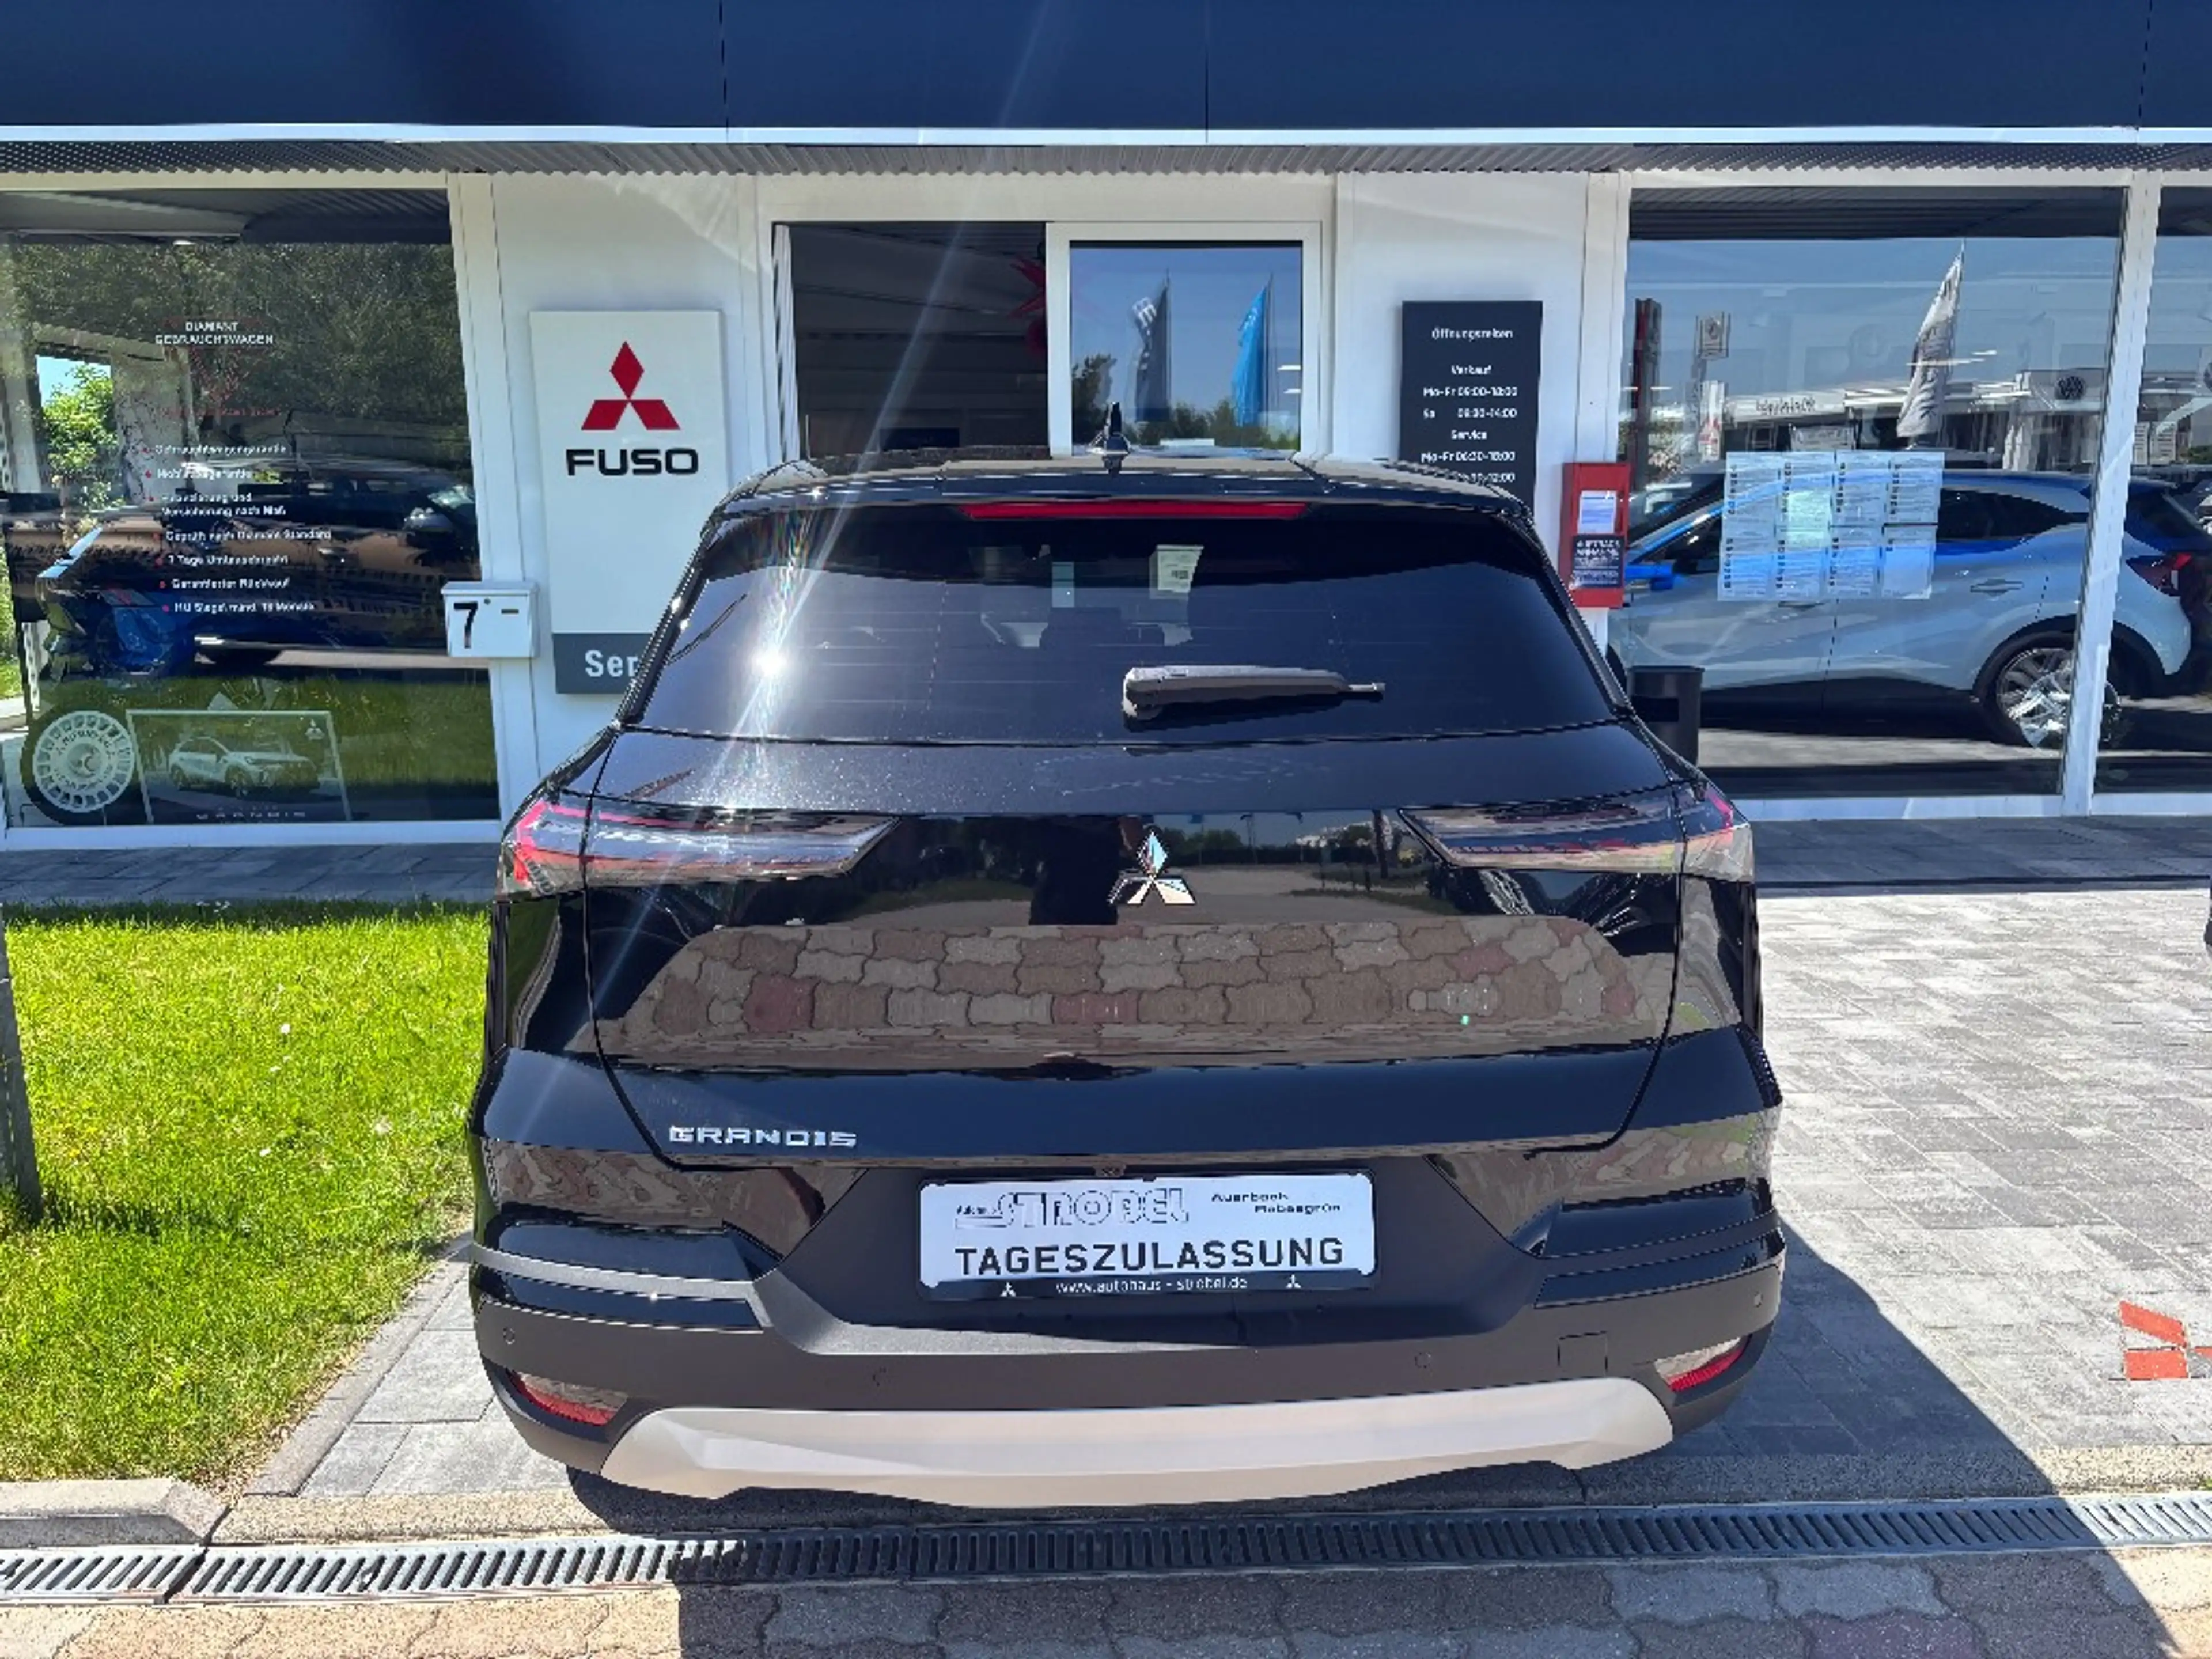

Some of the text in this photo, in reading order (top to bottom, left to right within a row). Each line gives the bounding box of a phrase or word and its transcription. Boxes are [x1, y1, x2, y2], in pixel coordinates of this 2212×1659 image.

[185, 321, 239, 332] DIAMANT
[155, 334, 274, 344] GEBRAUCHTWAGEN
[566, 448, 699, 476] FUSO
[453, 601, 479, 649] 7
[668, 1125, 857, 1148] GRANDIS
[1211, 1192, 1289, 1202] Auerbach
[955, 1237, 1344, 1275] TAGESZULASSUNG
